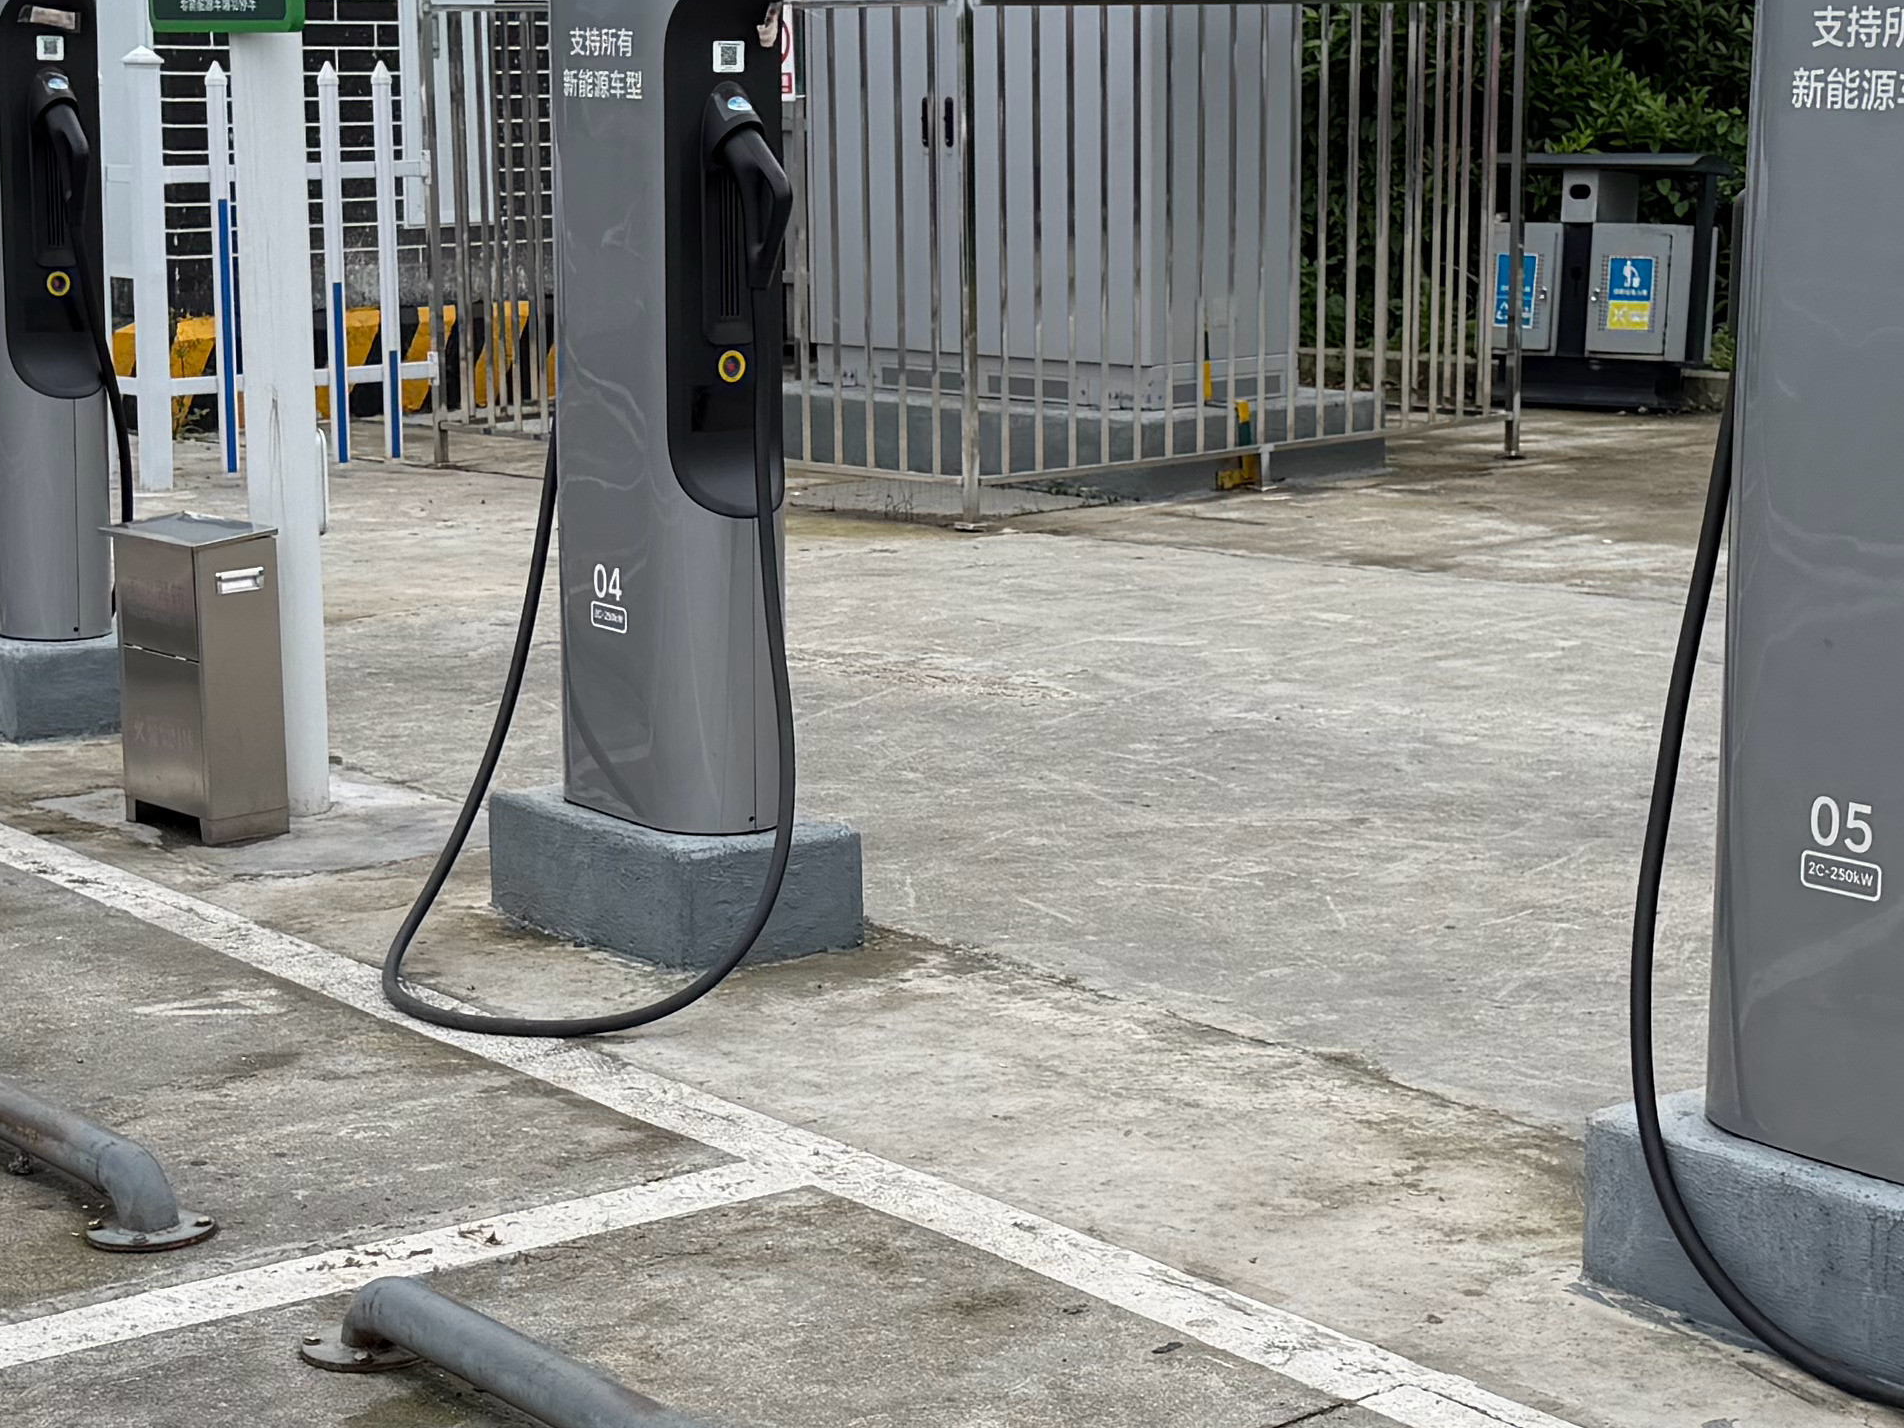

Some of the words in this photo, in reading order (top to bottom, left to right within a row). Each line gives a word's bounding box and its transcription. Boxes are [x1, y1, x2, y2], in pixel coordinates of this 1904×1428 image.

[570, 27, 634, 57] 支持所有
[563, 69, 642, 100] 新能源车型
[594, 564, 622, 601] 04
[1811, 796, 1872, 853] 05
[1808, 861, 1873, 887] 2C-250kW
